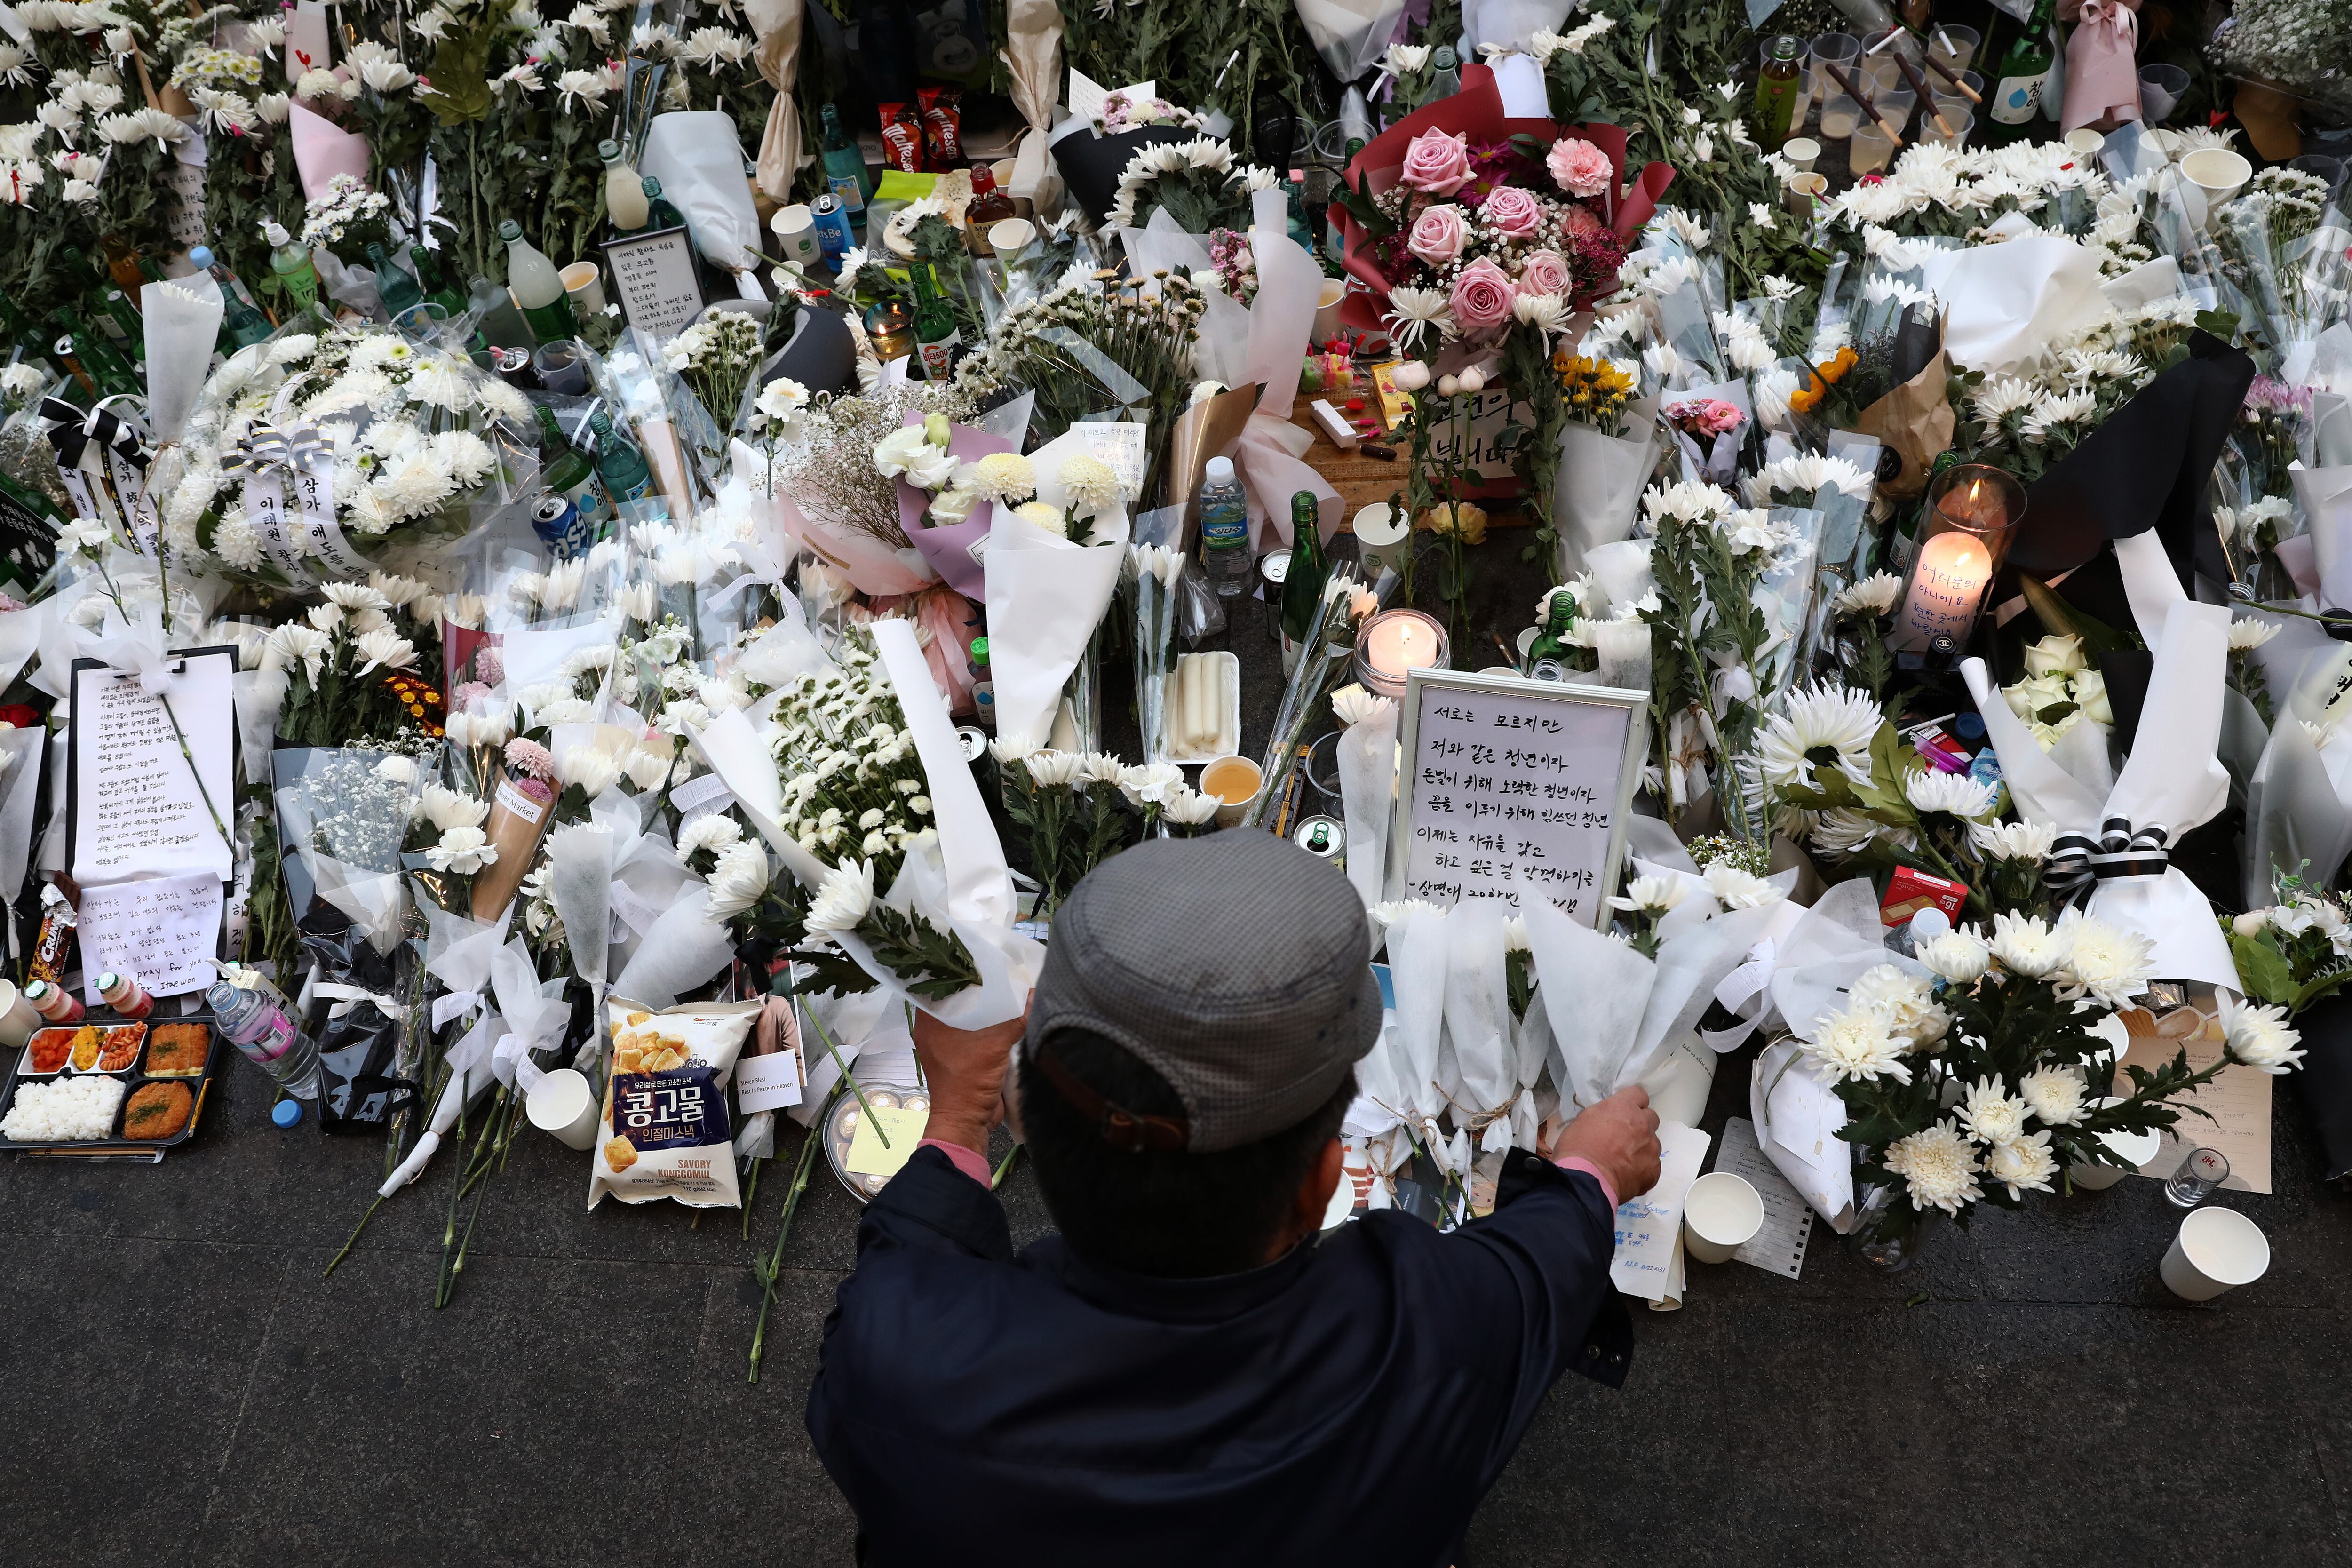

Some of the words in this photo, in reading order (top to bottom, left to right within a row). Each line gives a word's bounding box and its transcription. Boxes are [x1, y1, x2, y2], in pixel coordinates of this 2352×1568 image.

[882, 123, 914, 173] Malteser
[302, 478, 321, 512] 삼가
[260, 497, 281, 542] 이태원
[278, 549, 300, 573] 참사
[813, 543, 836, 561] Handmade
[1434, 707, 1474, 722] 서로는
[1494, 714, 1564, 733] 모르지만
[1431, 738, 1464, 758] 저와
[1471, 743, 1496, 764] 같은
[1422, 768, 1457, 787] 돈벌기
[1464, 774, 1493, 792] 위해
[1499, 779, 1539, 797] 노력한
[509, 799, 534, 819] Market
[1428, 794, 1454, 812] 꿈을
[1465, 800, 1501, 819] 이루기
[1505, 804, 1534, 821] 위해
[1541, 809, 1577, 827] 힘쓰던
[1417, 826, 1459, 843] 이제는
[1468, 833, 1506, 853] 자유를
[1517, 841, 1546, 858] 갖고
[1435, 853, 1462, 868] 하고
[1470, 860, 1493, 875] 싶은
[1500, 862, 1513, 880] 걸
[137, 968, 161, 981] pray
[169, 963, 183, 973] for
[160, 977, 196, 990] Itaewon
[667, 1078, 681, 1087] 고소한
[624, 1086, 704, 1128] 콩고물
[658, 1169, 711, 1179] KONGGOMUL
[678, 1159, 711, 1169] SAVORY
